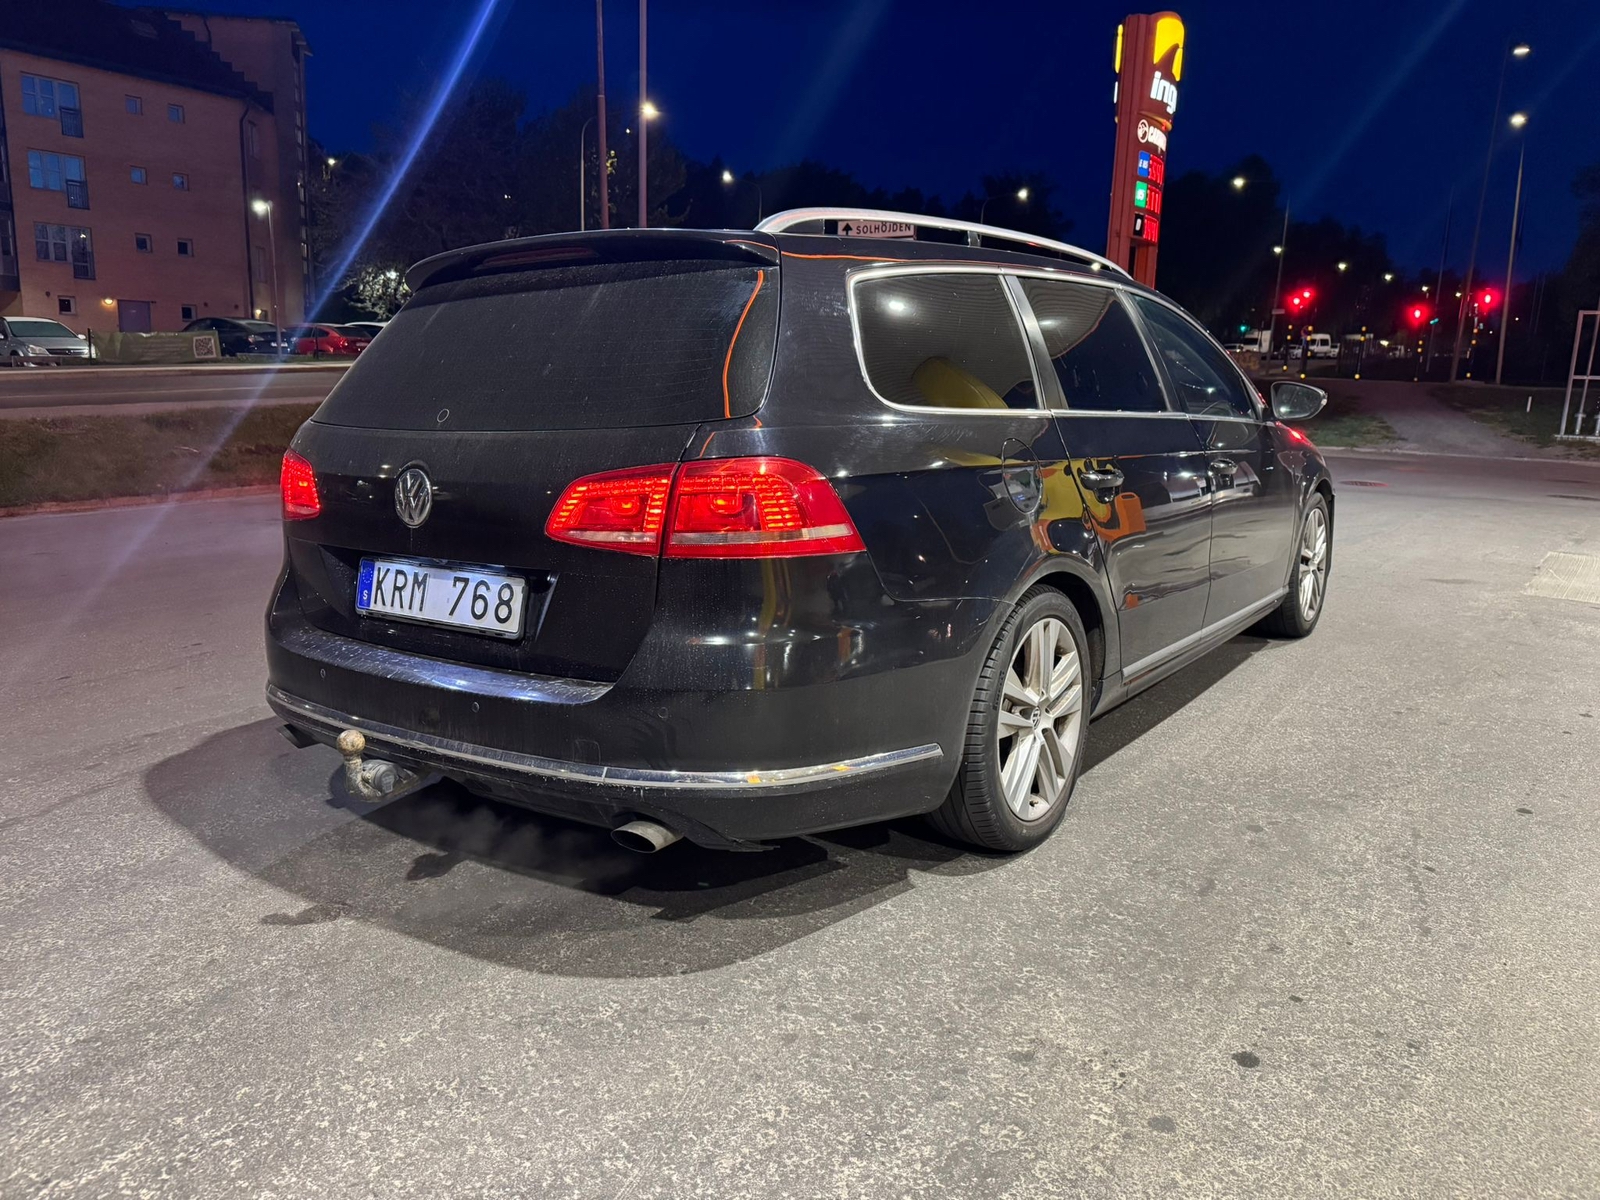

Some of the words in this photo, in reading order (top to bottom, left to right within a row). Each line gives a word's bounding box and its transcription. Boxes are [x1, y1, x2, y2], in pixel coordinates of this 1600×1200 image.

[856, 222, 911, 235] SOLHÖJDEN
[362, 589, 368, 600] S
[374, 566, 430, 612] KRM
[448, 575, 515, 624] 768
